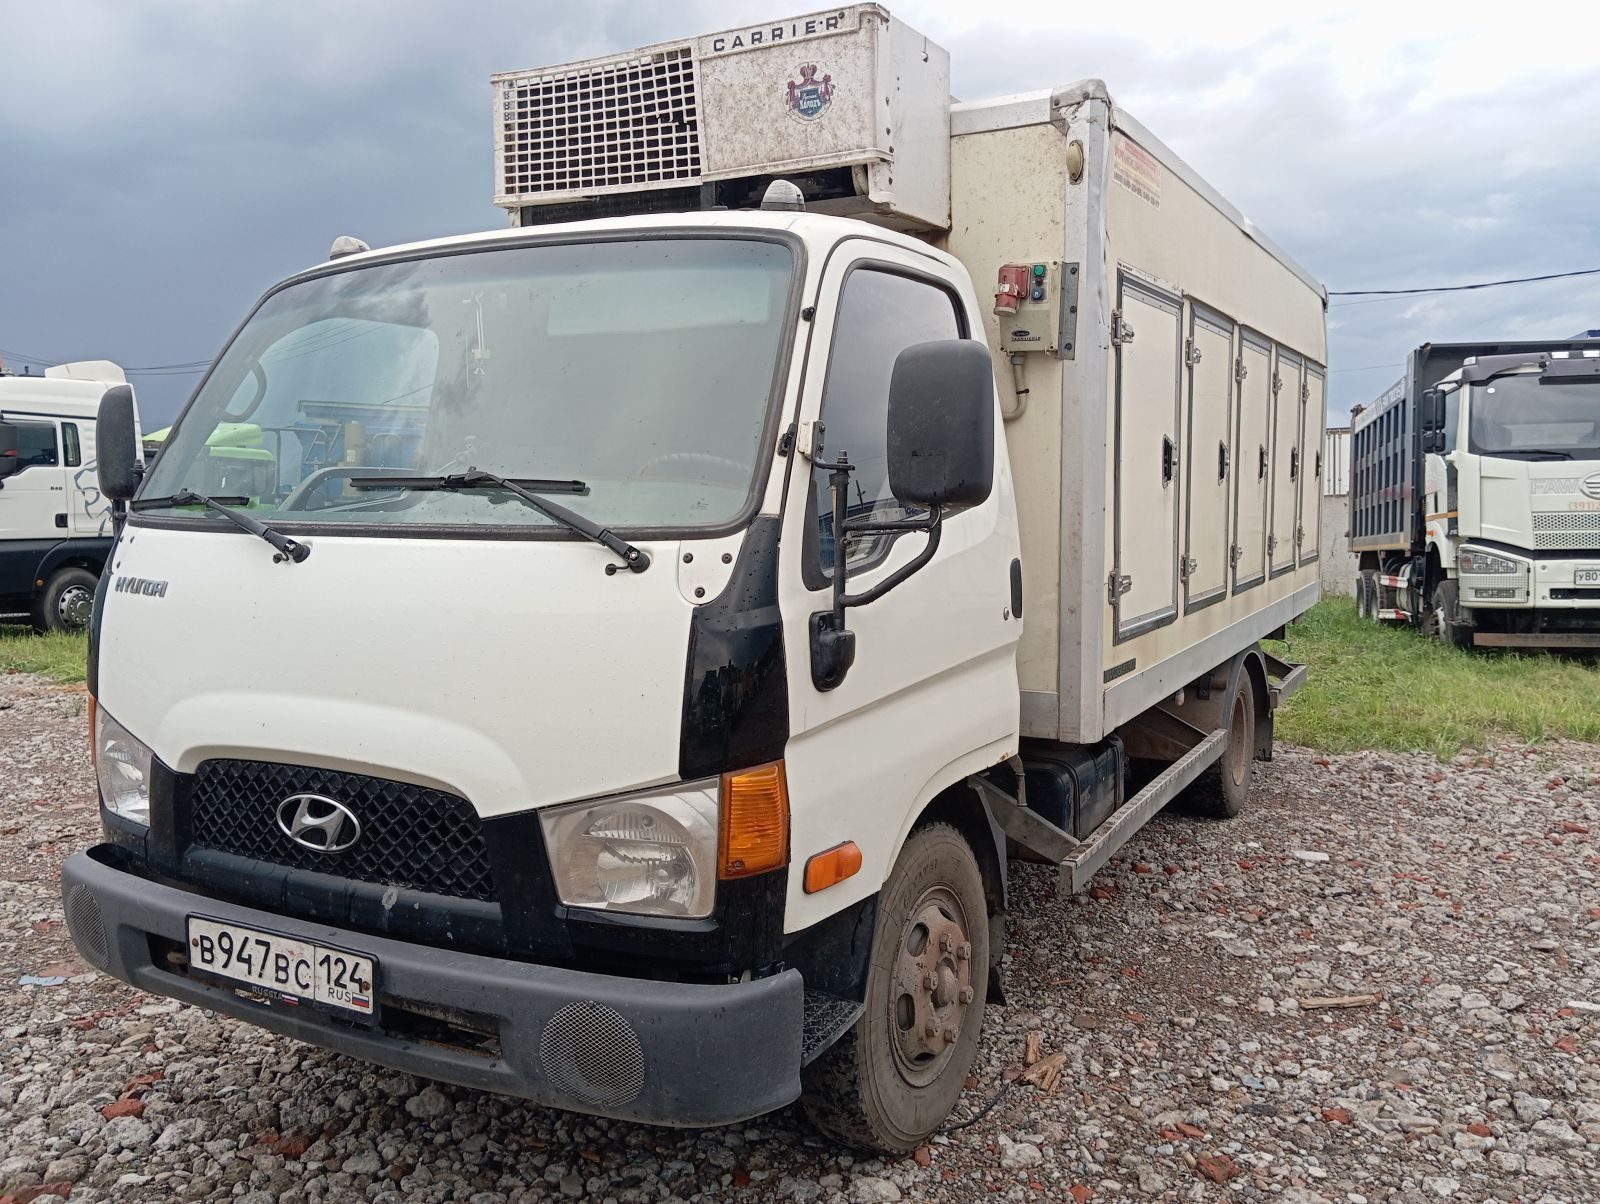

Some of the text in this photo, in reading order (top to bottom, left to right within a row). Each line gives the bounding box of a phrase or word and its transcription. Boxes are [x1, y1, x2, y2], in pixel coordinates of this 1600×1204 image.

[713, 16, 838, 51] CARRIER
[1530, 479, 1579, 495] FAW
[115, 576, 168, 598] HYUNDAI
[319, 954, 363, 993] 124
[328, 986, 351, 1002] RUS
